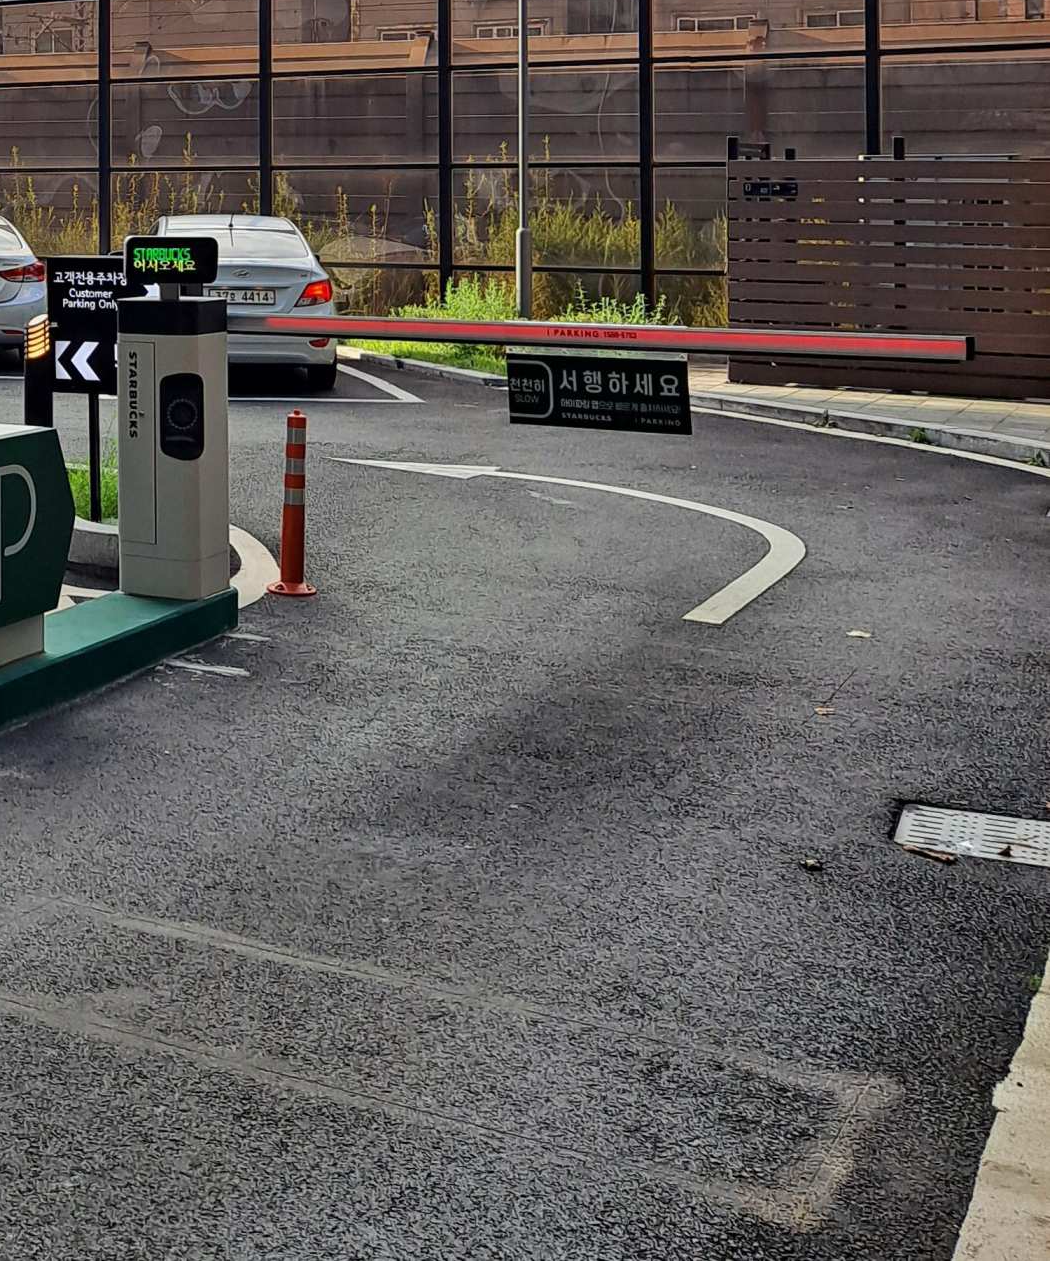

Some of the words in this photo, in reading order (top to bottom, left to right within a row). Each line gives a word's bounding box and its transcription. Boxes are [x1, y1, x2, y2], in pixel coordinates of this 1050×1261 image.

[133, 247, 191, 261] STARBUCKS
[133, 260, 197, 273] 어서오세요
[68, 287, 114, 299] Customer
[241, 291, 269, 302] 4414
[62, 299, 96, 311] Parking
[553, 329, 600, 338] PARKING
[509, 377, 545, 394] 천천히
[128, 351, 138, 439] STARBUCKS
[514, 394, 540, 403] SLOW
[561, 412, 613, 422] STARBUCKS
[640, 418, 682, 427] PARKING
